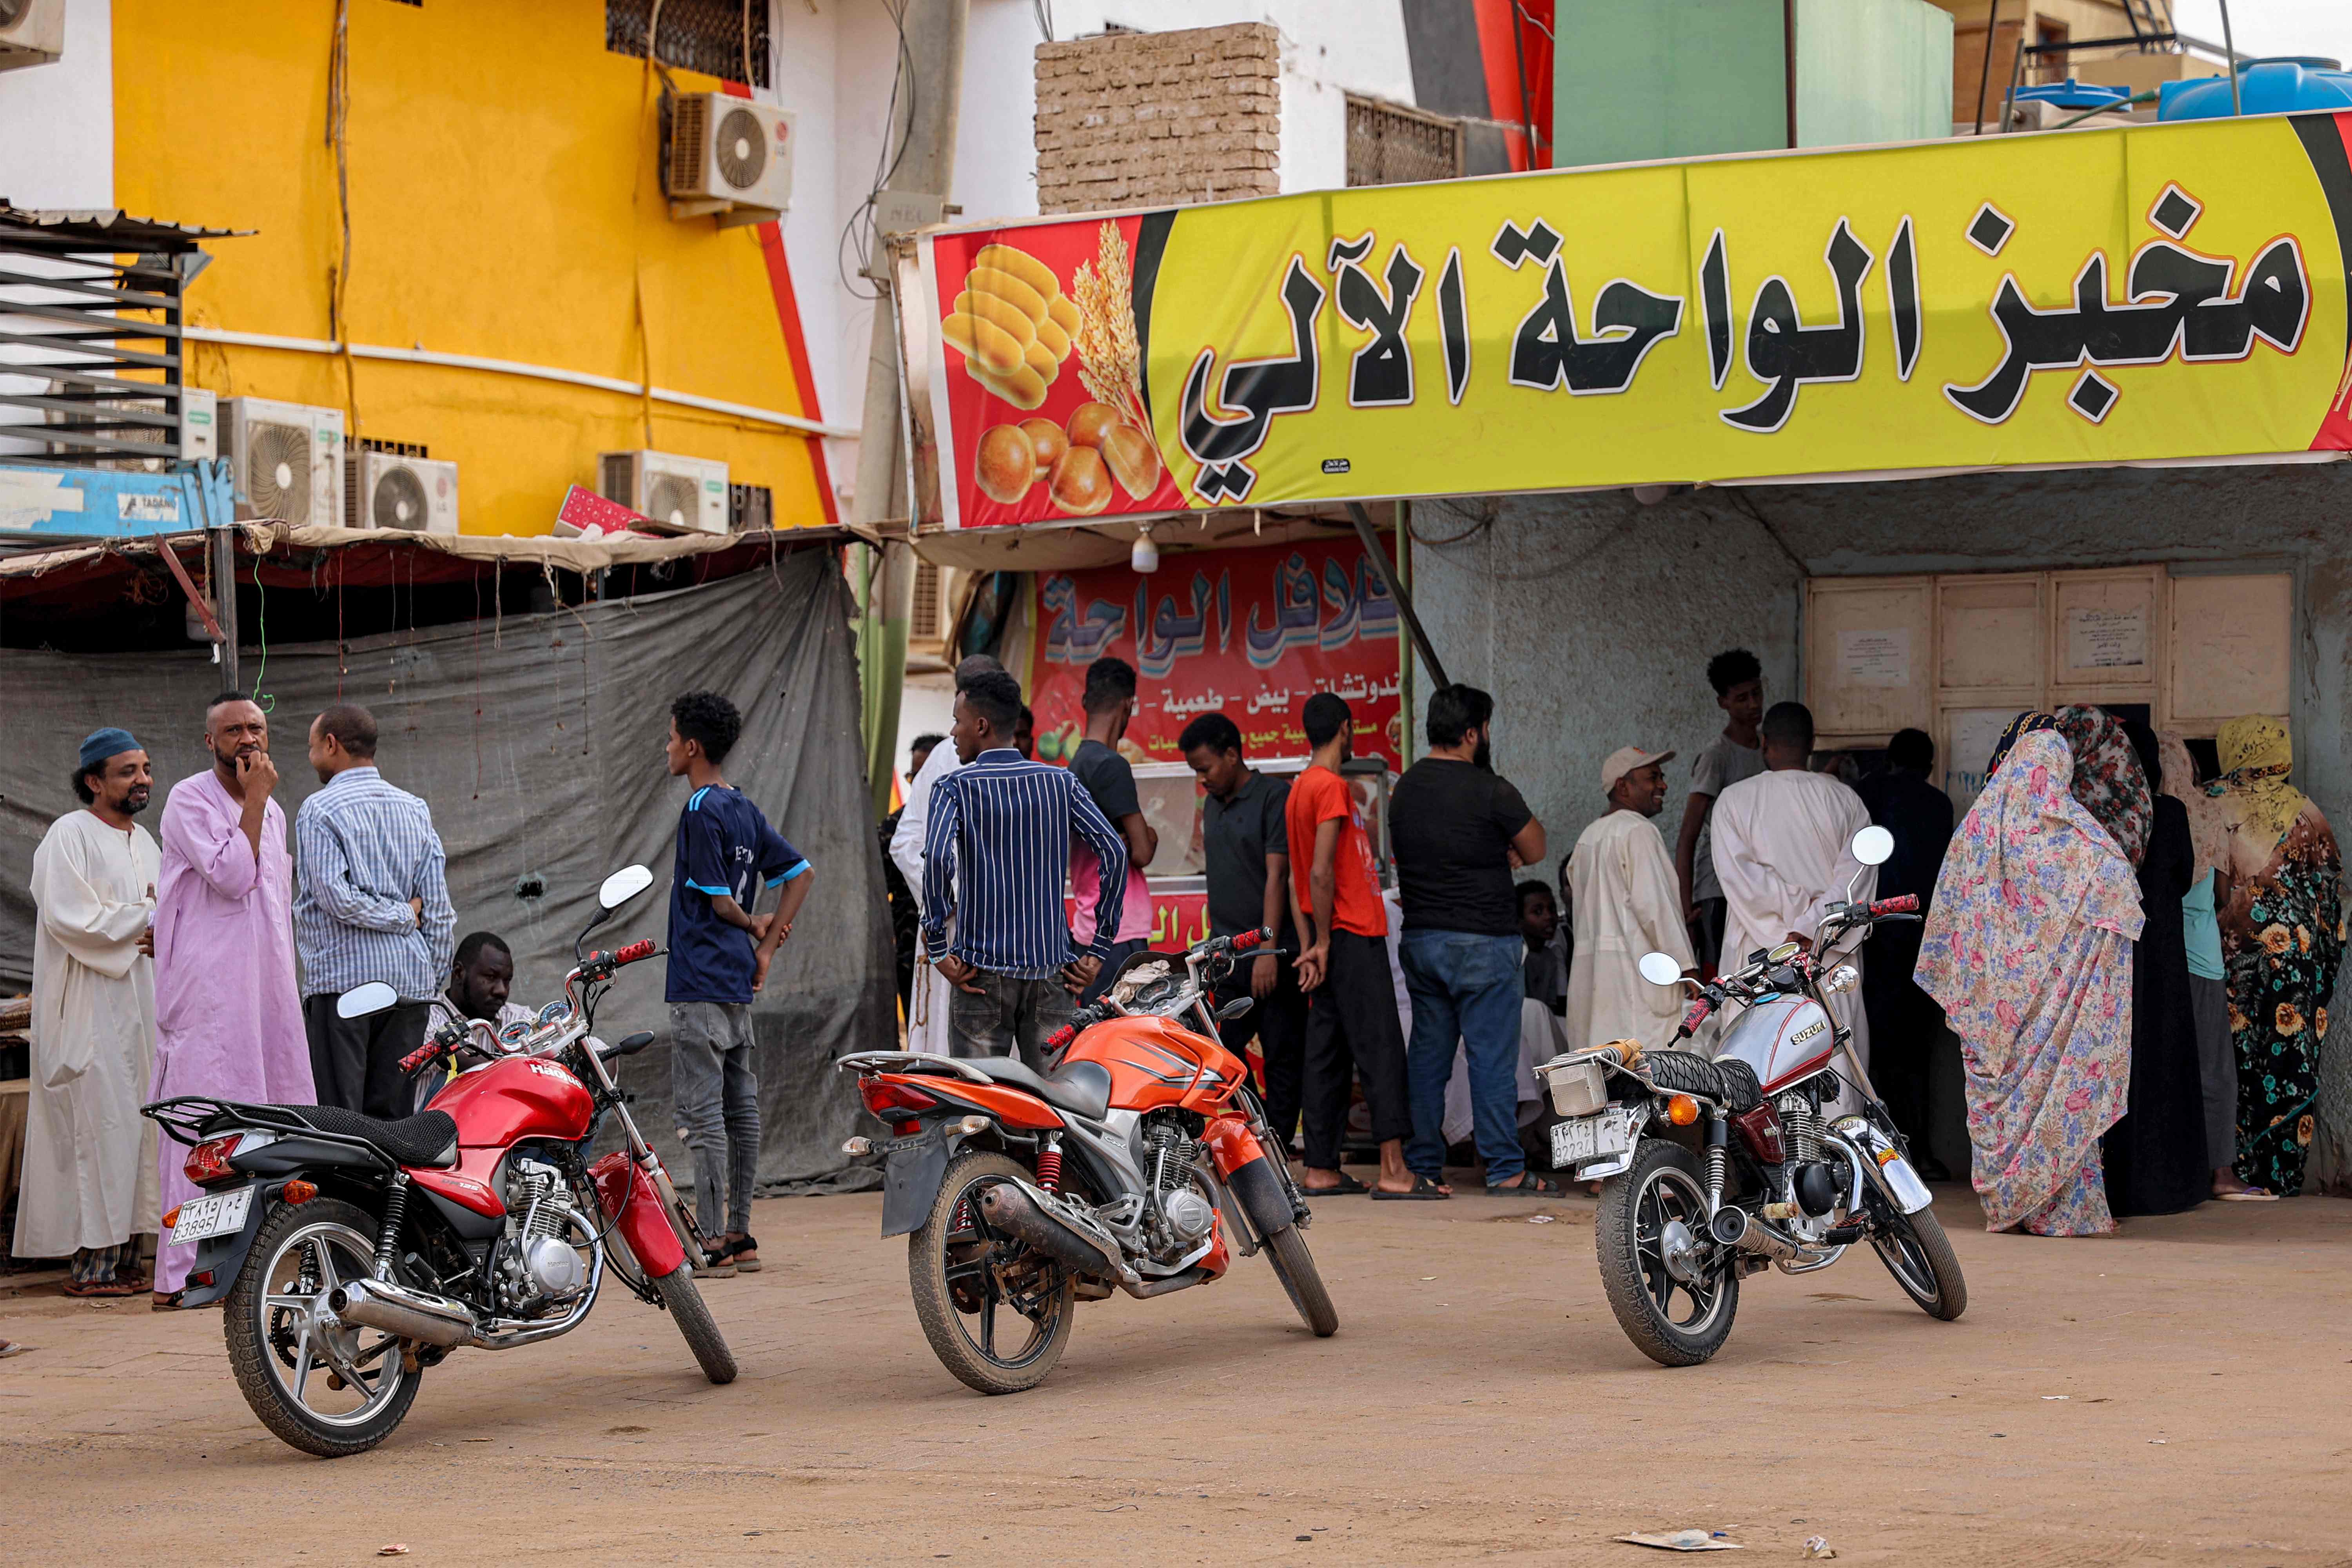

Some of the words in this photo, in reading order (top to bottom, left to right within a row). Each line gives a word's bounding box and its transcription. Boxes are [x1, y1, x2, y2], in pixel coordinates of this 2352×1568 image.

[1943, 183, 2310, 424] مخبز
[1492, 215, 1922, 432] الواحة
[1181, 230, 1471, 503] الآلي
[1043, 568, 1232, 679] الواحة
[1161, 686, 1224, 720] طعمية
[1246, 683, 1289, 713] بيض
[1312, 672, 1400, 704] ندوتشات
[1249, 730, 1280, 750] جميع
[1791, 1020, 1826, 1045] SUZUKI
[529, 1063, 583, 1090] Haojue
[1104, 1136, 1128, 1150] Cool
[1555, 1139, 1591, 1163] 92234
[174, 1216, 214, 1239] 63895
